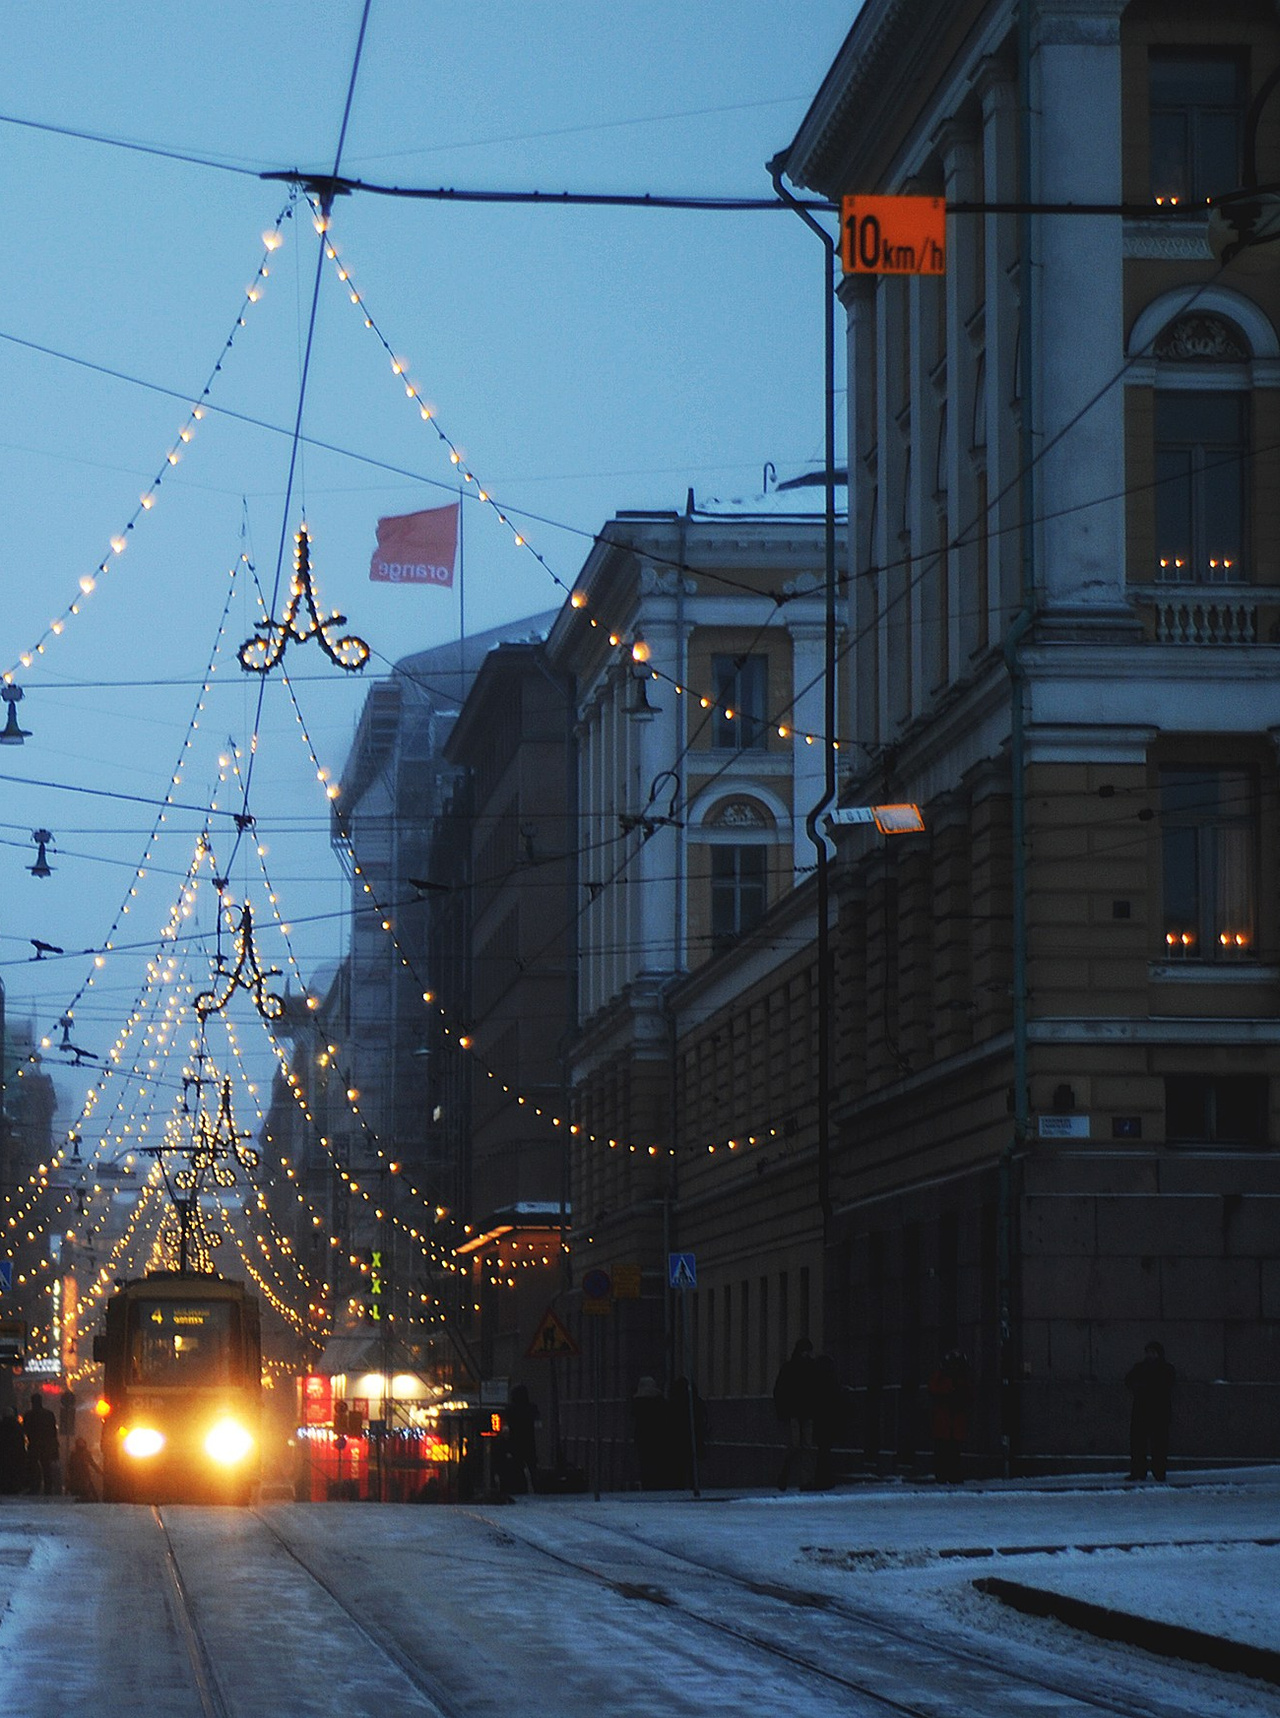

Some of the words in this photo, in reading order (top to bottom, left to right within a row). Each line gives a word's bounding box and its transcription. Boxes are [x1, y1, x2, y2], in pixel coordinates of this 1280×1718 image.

[846, 214, 880, 268] 10
[882, 236, 943, 272] km/h
[151, 1308, 164, 1325] 4
